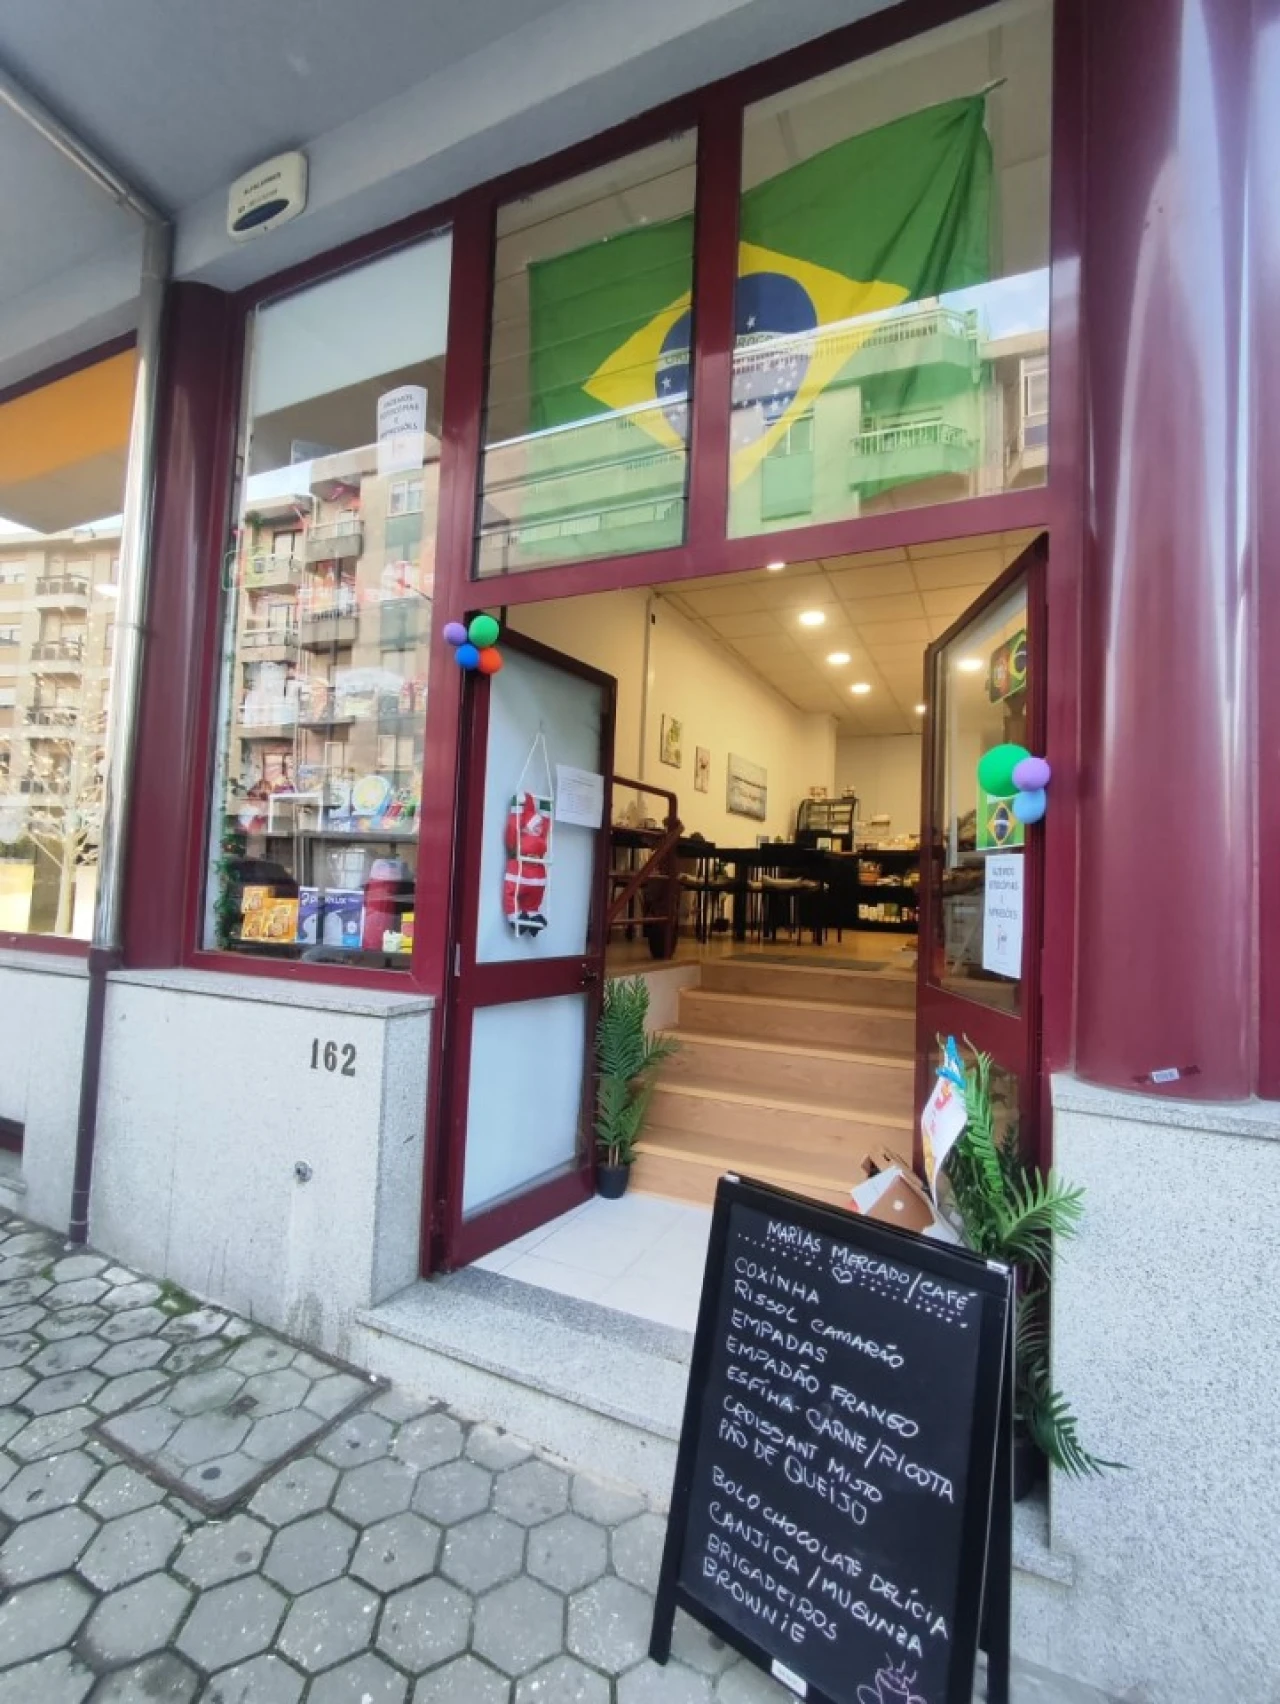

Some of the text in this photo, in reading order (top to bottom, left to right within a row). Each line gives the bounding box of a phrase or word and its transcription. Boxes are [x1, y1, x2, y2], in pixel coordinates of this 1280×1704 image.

[310, 1037, 356, 1077] 162
[766, 1220, 822, 1253] MARIAS
[734, 1279, 799, 1324] RISSOL
[730, 1307, 829, 1364] EMPADAS
[725, 1334, 920, 1438] EMPADÃO FRANGO
[718, 1417, 749, 1449] PÃO
[753, 1437, 779, 1467] DE
[711, 1464, 761, 1511] BOLO
[761, 1505, 863, 1578] CHOCOLATE
[706, 1532, 838, 1641] BRIGADEIROS
